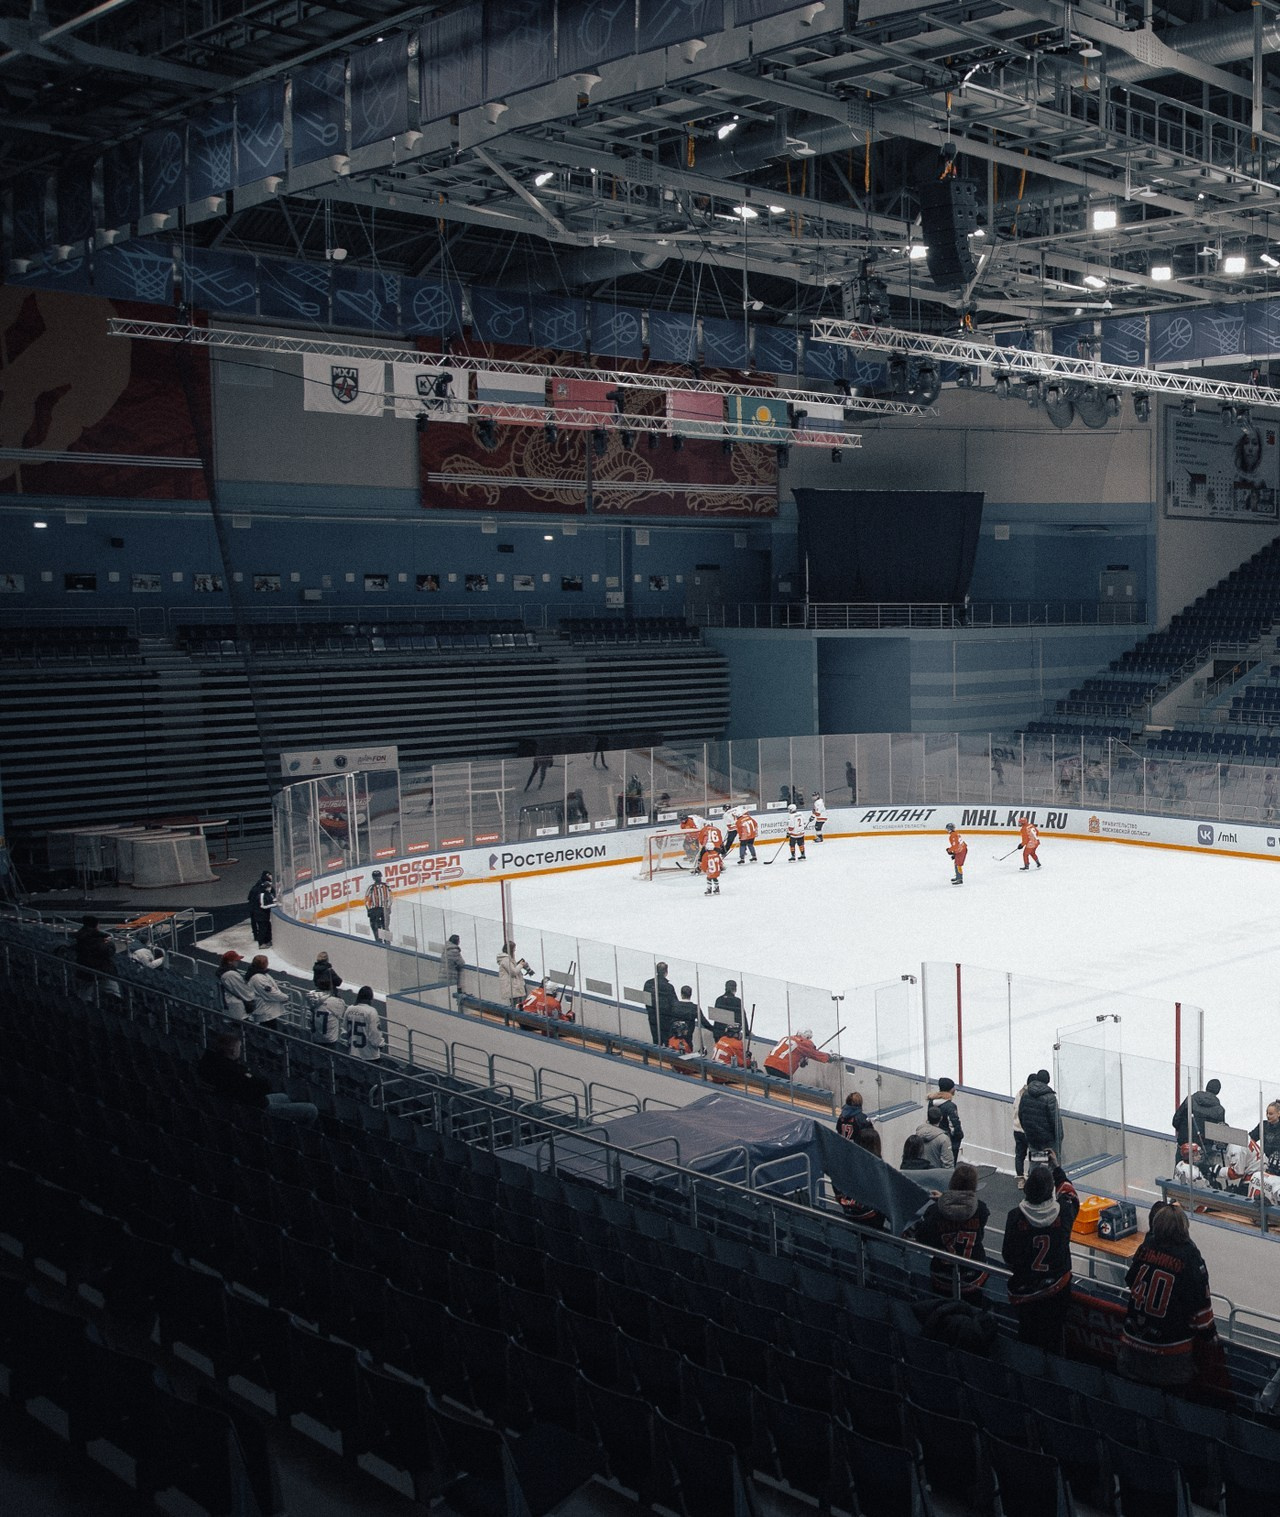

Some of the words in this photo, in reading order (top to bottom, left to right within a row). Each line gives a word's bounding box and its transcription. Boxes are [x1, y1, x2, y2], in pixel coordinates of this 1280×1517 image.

[332, 367, 358, 378] МХЛ
[859, 808, 937, 823] АТЛАНТ
[961, 809, 1069, 830] MHL.KHL.RU
[1217, 832, 1238, 843] /mhl
[384, 854, 461, 878] МОСОБЛ
[501, 844, 607, 869] Ростелеком
[385, 870, 443, 889] СПОРТ
[1032, 1234, 1051, 1272] 2
[1131, 1264, 1176, 1318] 40
